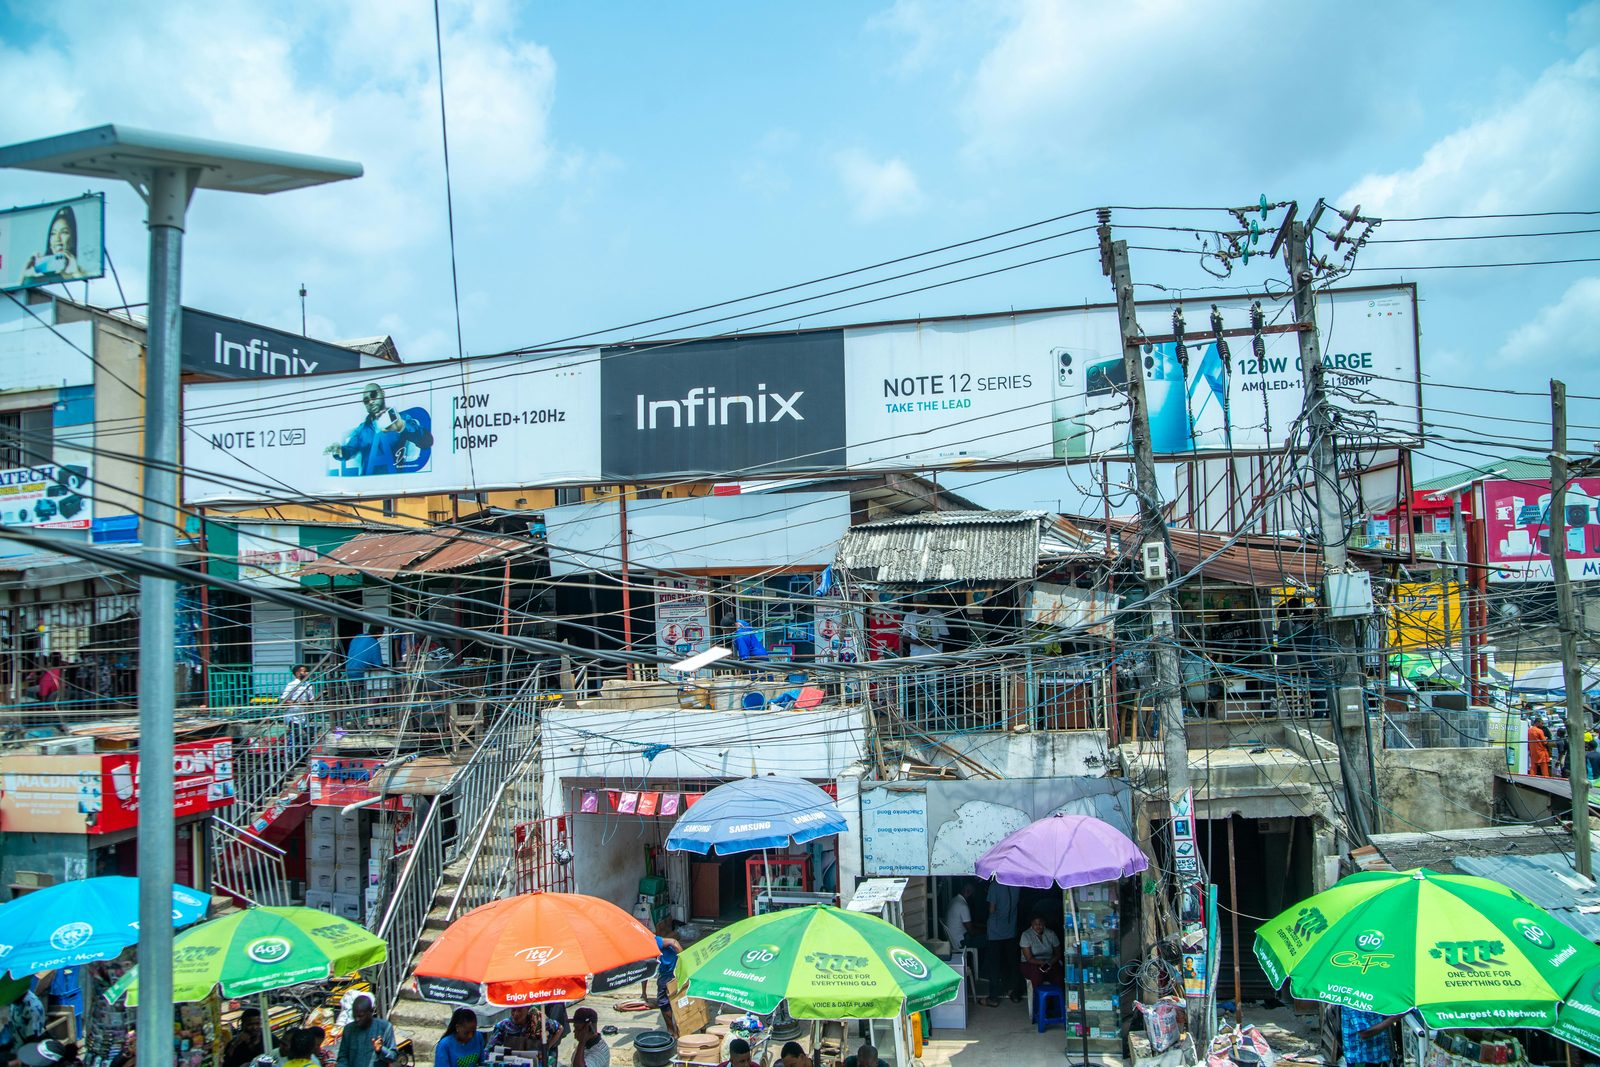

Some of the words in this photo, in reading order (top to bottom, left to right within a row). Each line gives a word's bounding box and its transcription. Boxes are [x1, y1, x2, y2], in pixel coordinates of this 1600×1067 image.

[214, 331, 318, 378] Infinix
[1238, 357, 1288, 375] 120W
[1295, 352, 1373, 372] CARGE
[883, 375, 944, 398] NOTE
[948, 373, 971, 393] 12
[977, 373, 1032, 392] SERIES
[453, 393, 490, 410] 120W
[636, 383, 805, 430] Infinix
[885, 401, 915, 414] TAKE
[917, 399, 939, 412] THE
[941, 398, 971, 411] LEAD
[453, 409, 566, 429] AMOLED+120Hz
[212, 431, 255, 450] NOTE
[259, 430, 276, 447] 12
[454, 434, 499, 450] 108MP
[792, 811, 827, 824] SAMSUNG
[729, 821, 771, 834] SAMSUNG
[1358, 933, 1381, 946] glo
[1522, 925, 1545, 945] glo
[746, 949, 774, 963] glo
[1549, 944, 1577, 968] Unlimited
[722, 968, 766, 983] Unlimited
[1467, 970, 1492, 978] CODE
[1445, 979, 1501, 988] EVERYTHING
[1502, 979, 1521, 987] GLO
[506, 992, 527, 1003] Enjoy
[529, 989, 551, 998] Better
[553, 988, 566, 996] Life
[1327, 983, 1353, 994] VOICE
[1353, 990, 1374, 1001] AND
[1319, 991, 1342, 1003] DATA
[1342, 996, 1373, 1011] PLANS
[1436, 1012, 1454, 1020] The
[1454, 1010, 1491, 1020] Largest
[1507, 1010, 1548, 1018] Network
